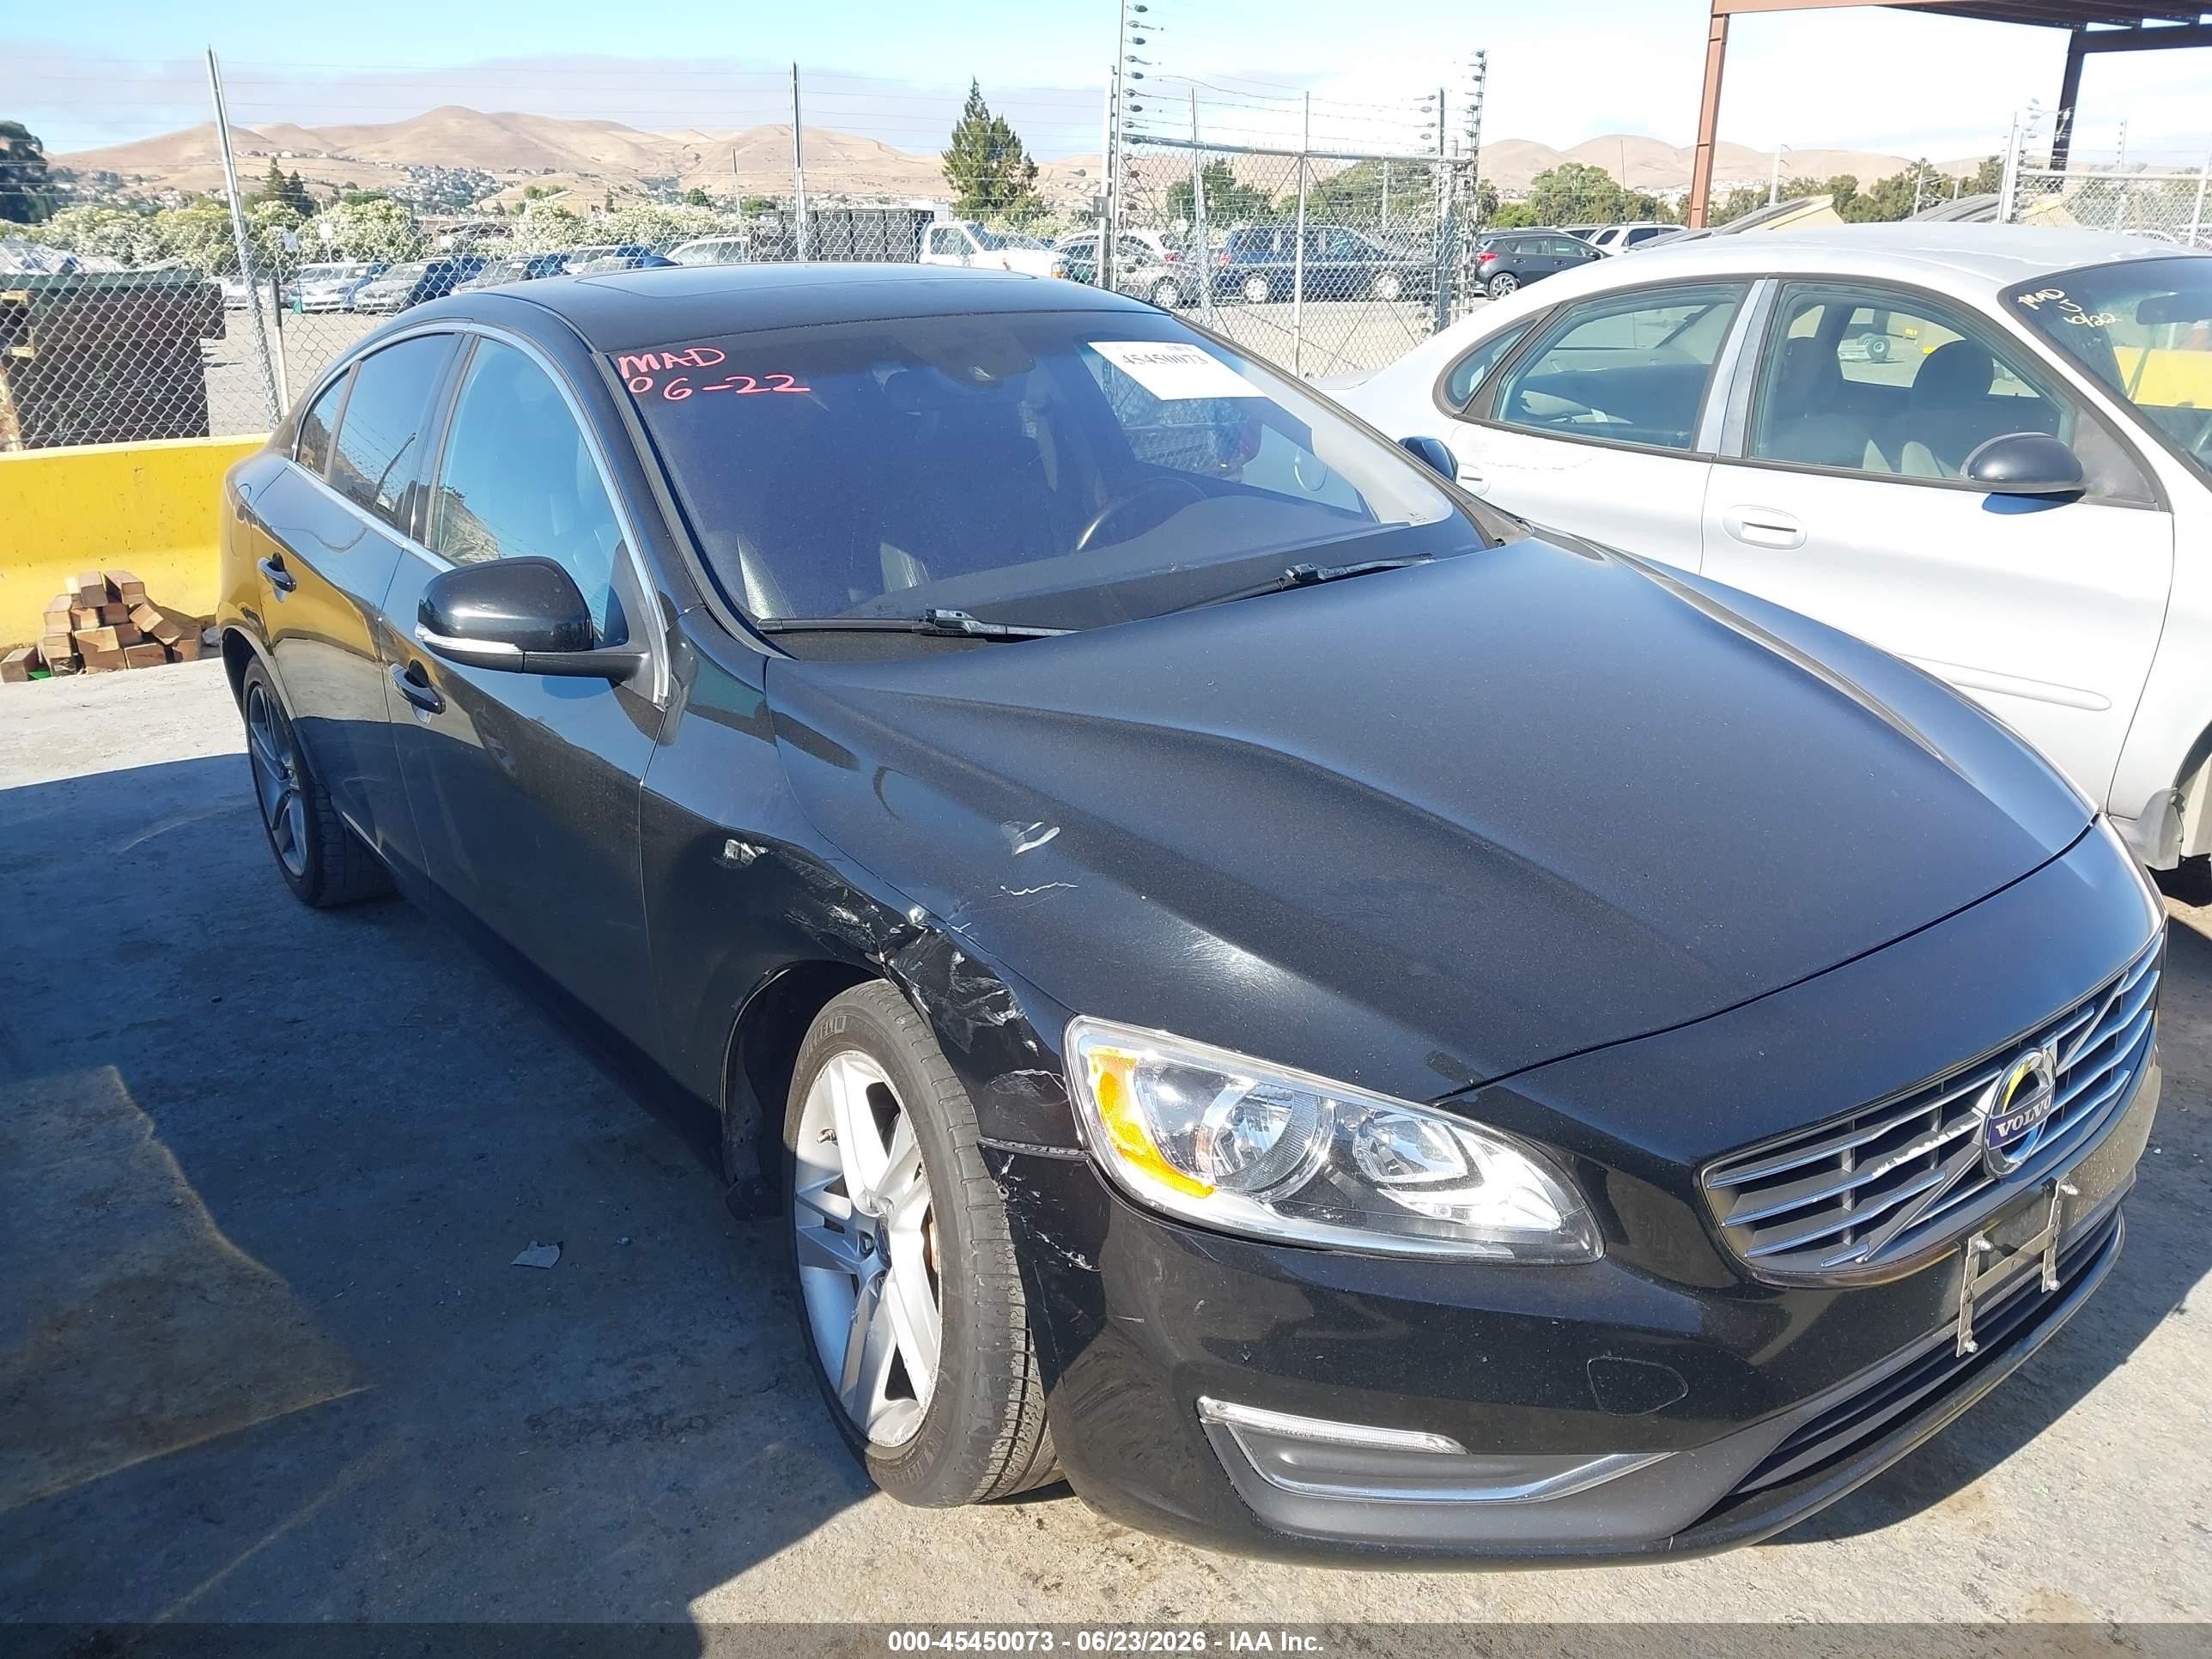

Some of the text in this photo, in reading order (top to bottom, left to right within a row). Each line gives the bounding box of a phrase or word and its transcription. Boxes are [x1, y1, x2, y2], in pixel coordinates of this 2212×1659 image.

[2017, 289, 2065, 310] MAD
[2063, 311, 2123, 328] 6/22
[618, 348, 726, 379] MAD
[1996, 1094, 2051, 1138] VOLVO
